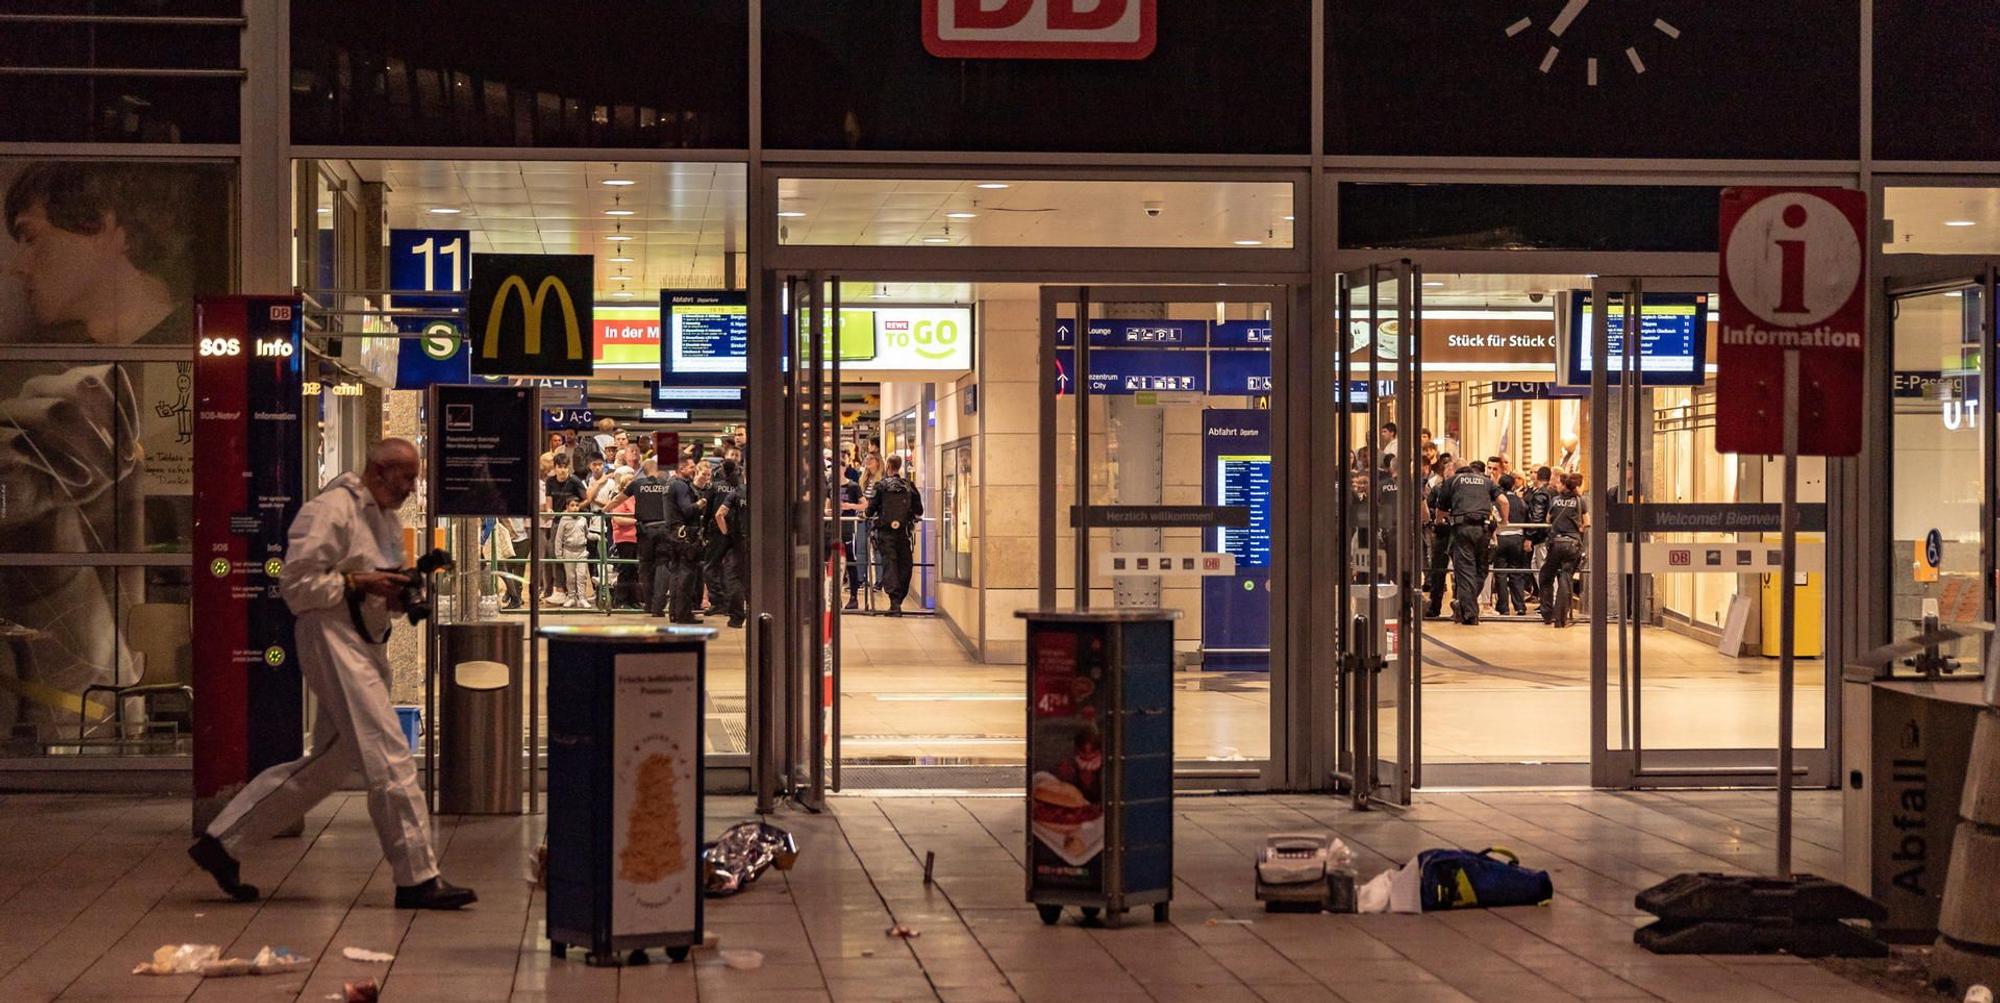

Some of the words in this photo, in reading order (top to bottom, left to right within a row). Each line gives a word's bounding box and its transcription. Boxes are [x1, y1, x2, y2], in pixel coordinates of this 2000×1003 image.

[412, 238, 461, 291] 11
[272, 308, 290, 319] DB
[605, 326, 617, 338] In
[621, 326, 643, 338] der
[886, 332, 909, 347] TO
[914, 320, 958, 344] GO
[1723, 326, 1860, 347] Information
[427, 325, 454, 357] S
[1448, 335, 1484, 347] Stück
[1486, 335, 1506, 347] für
[1510, 335, 1545, 347] Stück
[200, 338, 241, 356] SOS
[256, 338, 293, 357] Info
[1208, 427, 1237, 436] Abfahrt
[1461, 477, 1484, 485] POLIZEI
[1107, 511, 1149, 521] Herzlich
[1151, 511, 1214, 521] willkommen!
[1655, 512, 1721, 525] Welcome!
[1672, 552, 1688, 563] DB
[1892, 760, 1926, 896] Abfall
